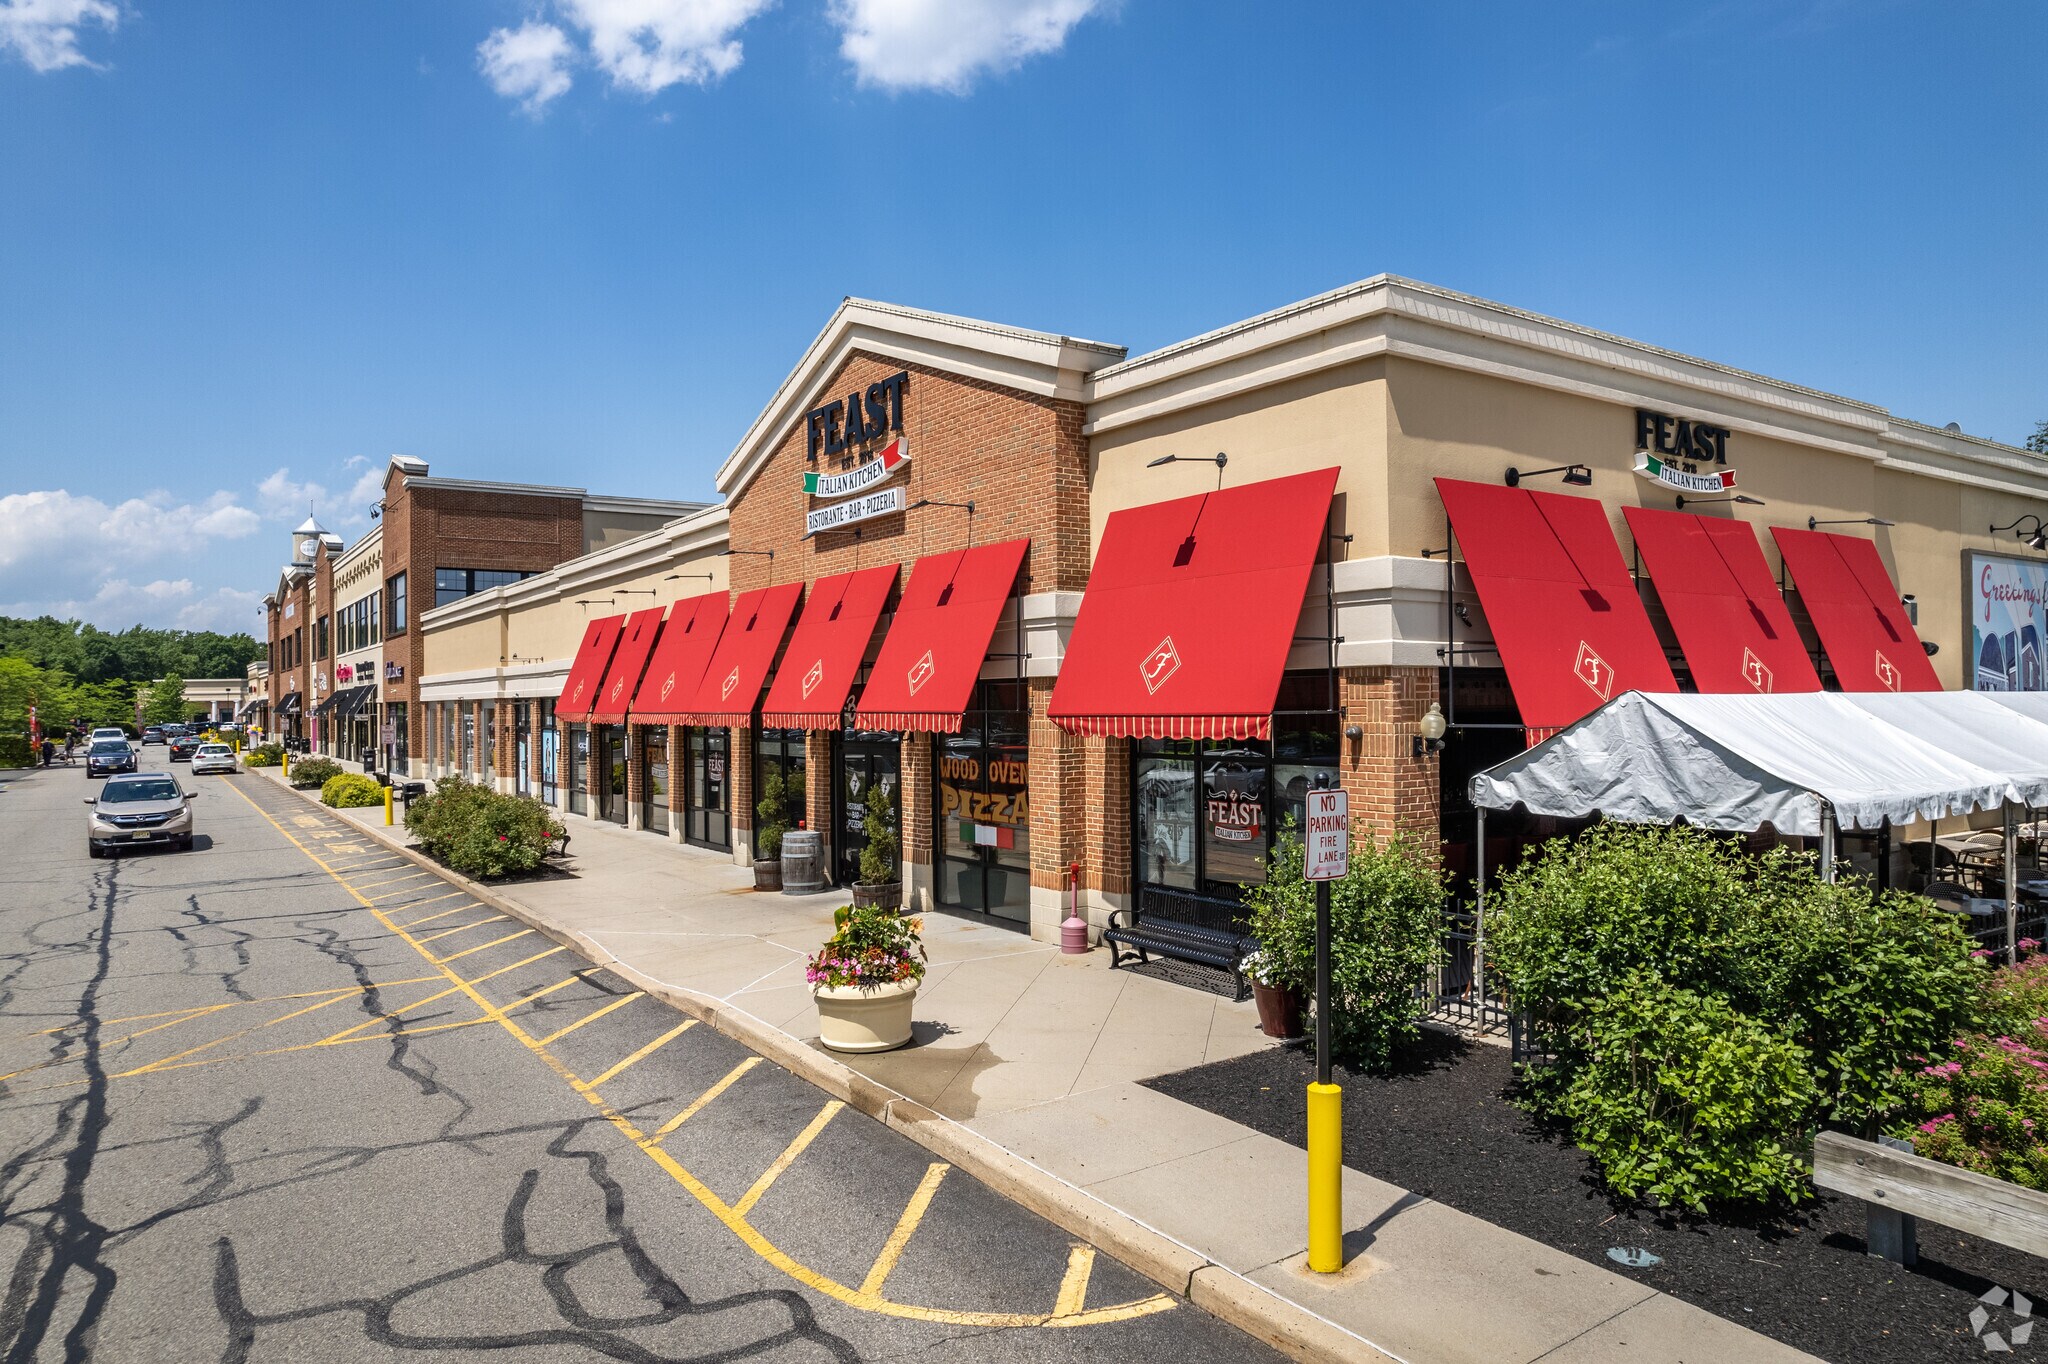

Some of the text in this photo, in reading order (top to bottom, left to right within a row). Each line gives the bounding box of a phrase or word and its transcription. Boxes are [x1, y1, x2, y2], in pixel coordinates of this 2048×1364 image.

[806, 371, 909, 461] FEAST
[1636, 410, 1731, 465] FEAST
[818, 458, 884, 494] ITALIAN KITCHEN
[1661, 466, 1722, 491] ITALIAN KITCHEN
[808, 491, 896, 529] RISTORANTE BAR PIZZERIA
[1981, 564, 2040, 622] Greetings
[709, 759, 725, 771] FEAST
[941, 757, 1029, 785] WOOD OVEN
[941, 782, 1029, 826] PIZZA
[1208, 800, 1261, 825] FEAST
[1321, 795, 1336, 812] NO
[1310, 814, 1346, 833] PARKING
[1320, 836, 1337, 848] FIRE
[1319, 851, 1338, 863] LANE
